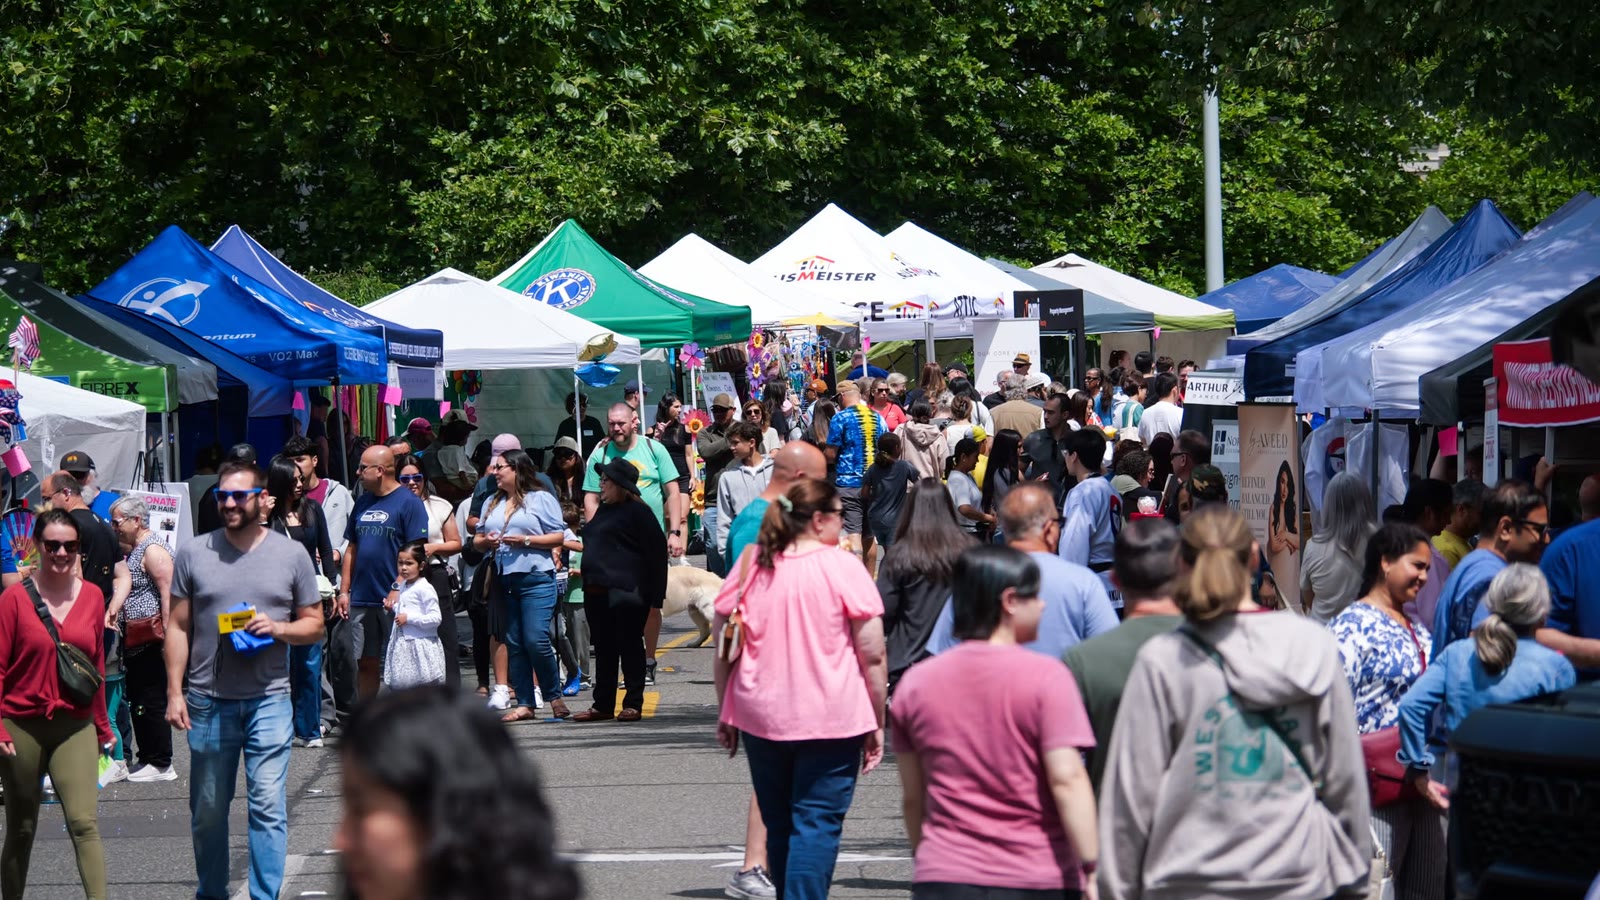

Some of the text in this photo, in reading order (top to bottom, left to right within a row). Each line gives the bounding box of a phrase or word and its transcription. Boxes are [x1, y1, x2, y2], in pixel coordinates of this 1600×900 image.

[537, 272, 586, 287] KIWANIS
[202, 332, 257, 341] entum
[268, 350, 293, 362] VO2
[295, 350, 319, 360] Max
[80, 381, 140, 395] FIBREX
[1187, 381, 1229, 393] ARTHUR
[145, 495, 177, 507] ONATE
[158, 505, 176, 514] HAIR!
